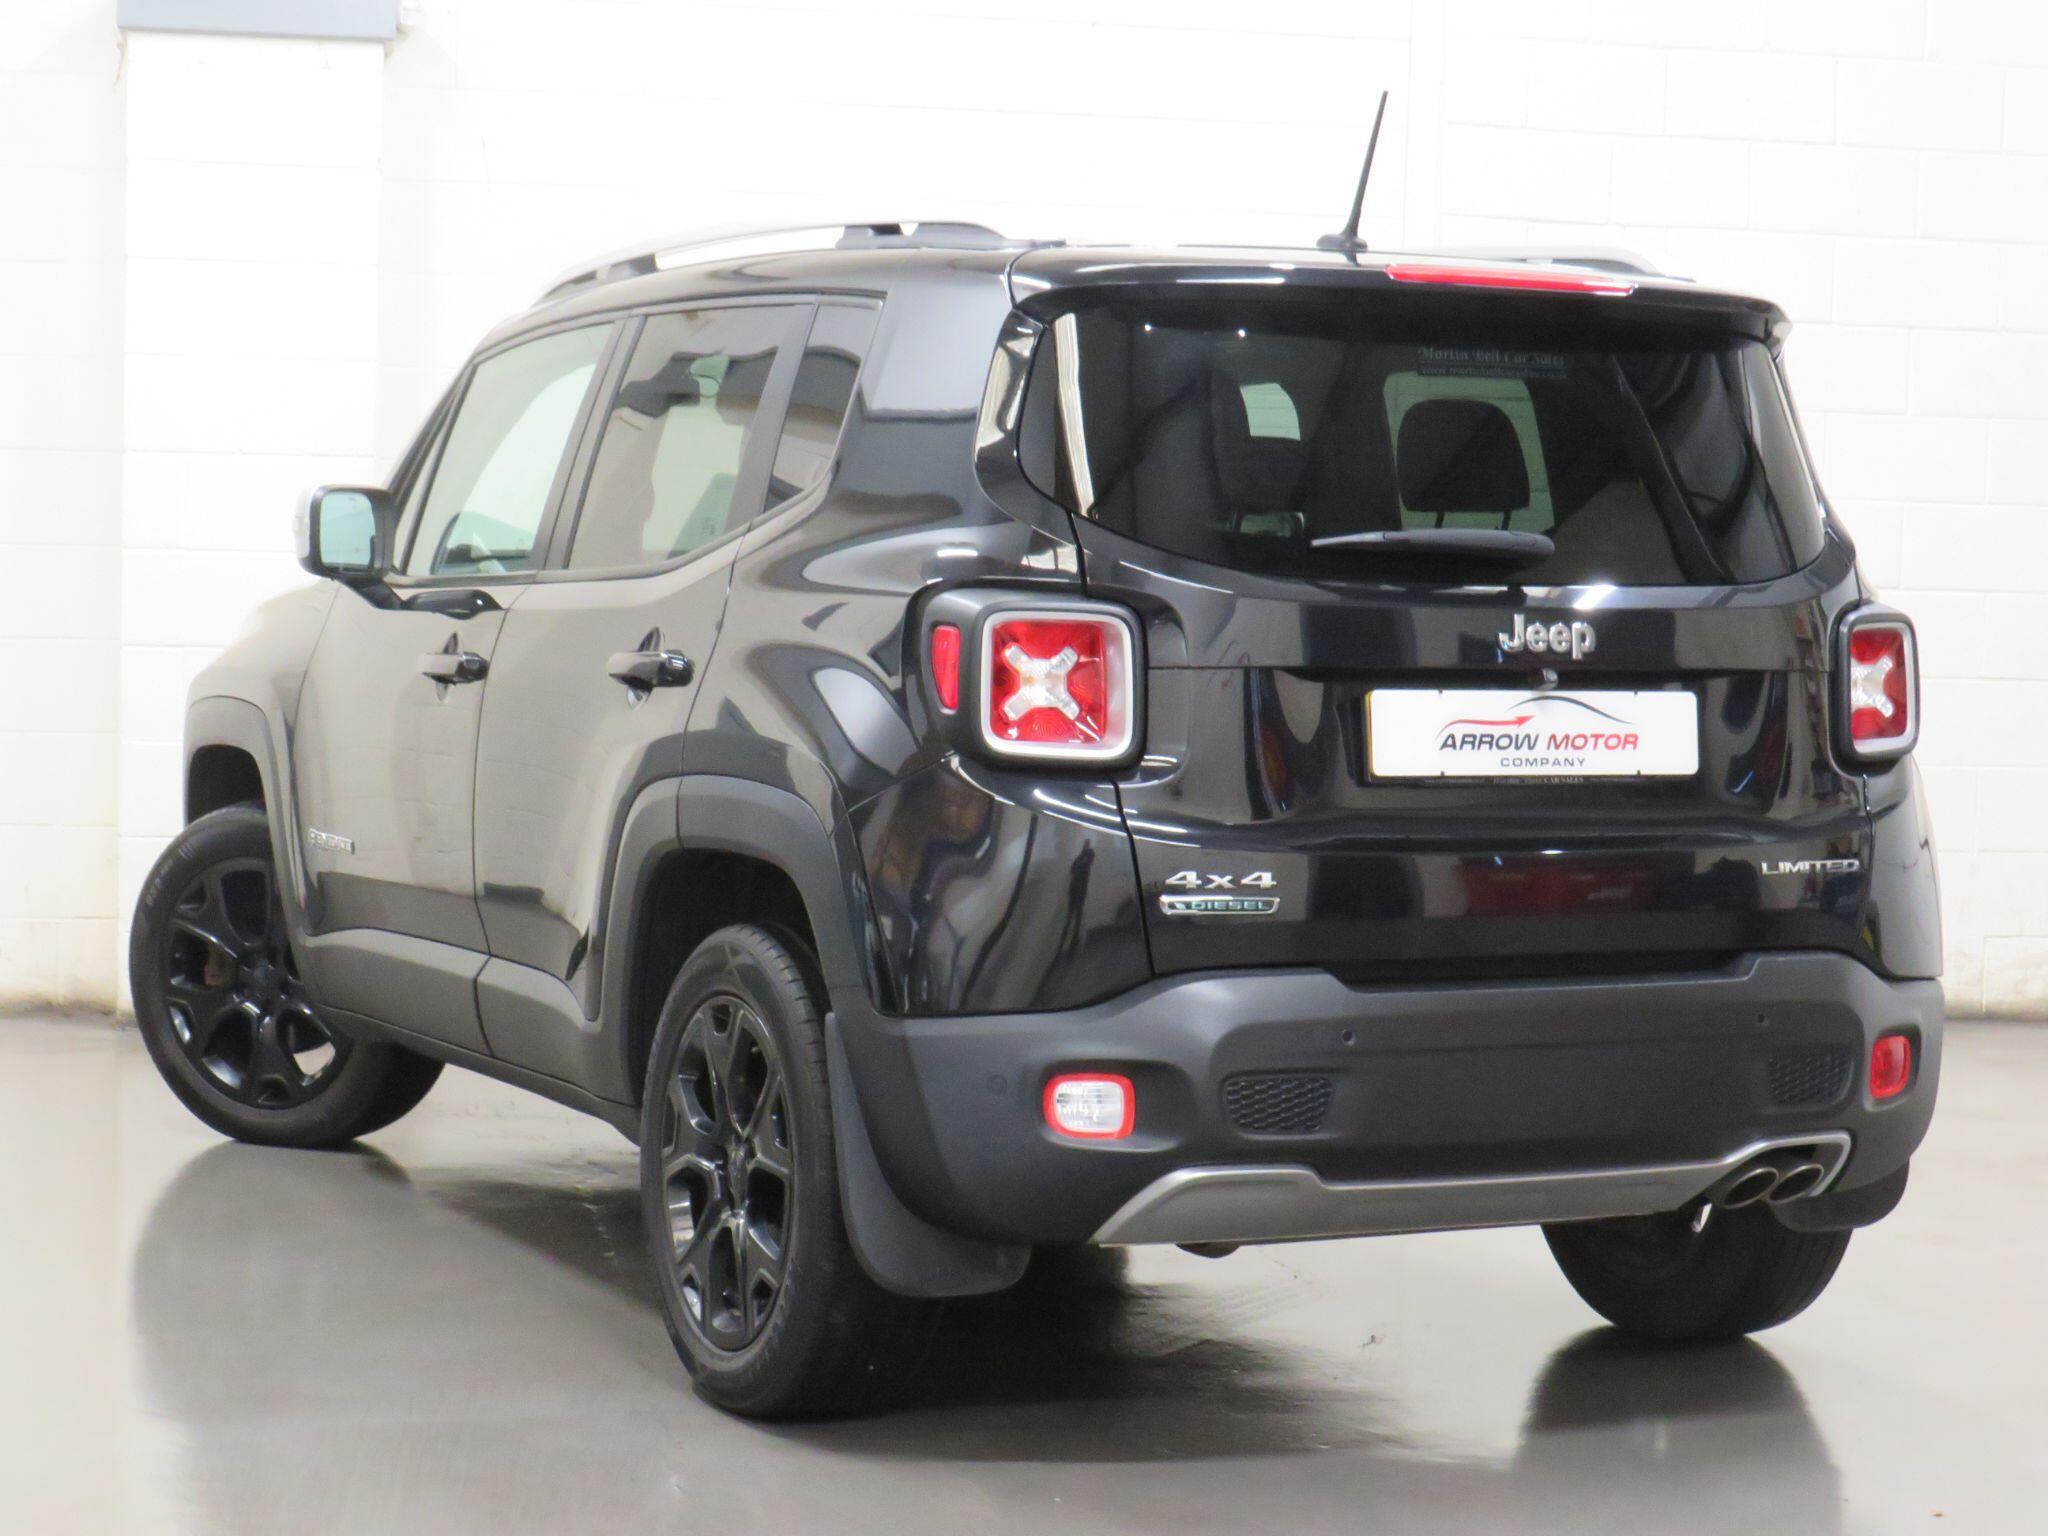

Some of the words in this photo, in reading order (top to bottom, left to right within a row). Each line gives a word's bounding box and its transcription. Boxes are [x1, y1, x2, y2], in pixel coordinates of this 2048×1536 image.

[1498, 613, 1596, 661] Jeep
[1439, 733, 1540, 751] ARROW
[1547, 733, 1640, 751] MOTOR
[1500, 757, 1586, 768] COMPANY
[1761, 858, 1860, 875] LIMITED
[1164, 870, 1278, 889] 4x4
[1191, 900, 1270, 911] DIESEL
